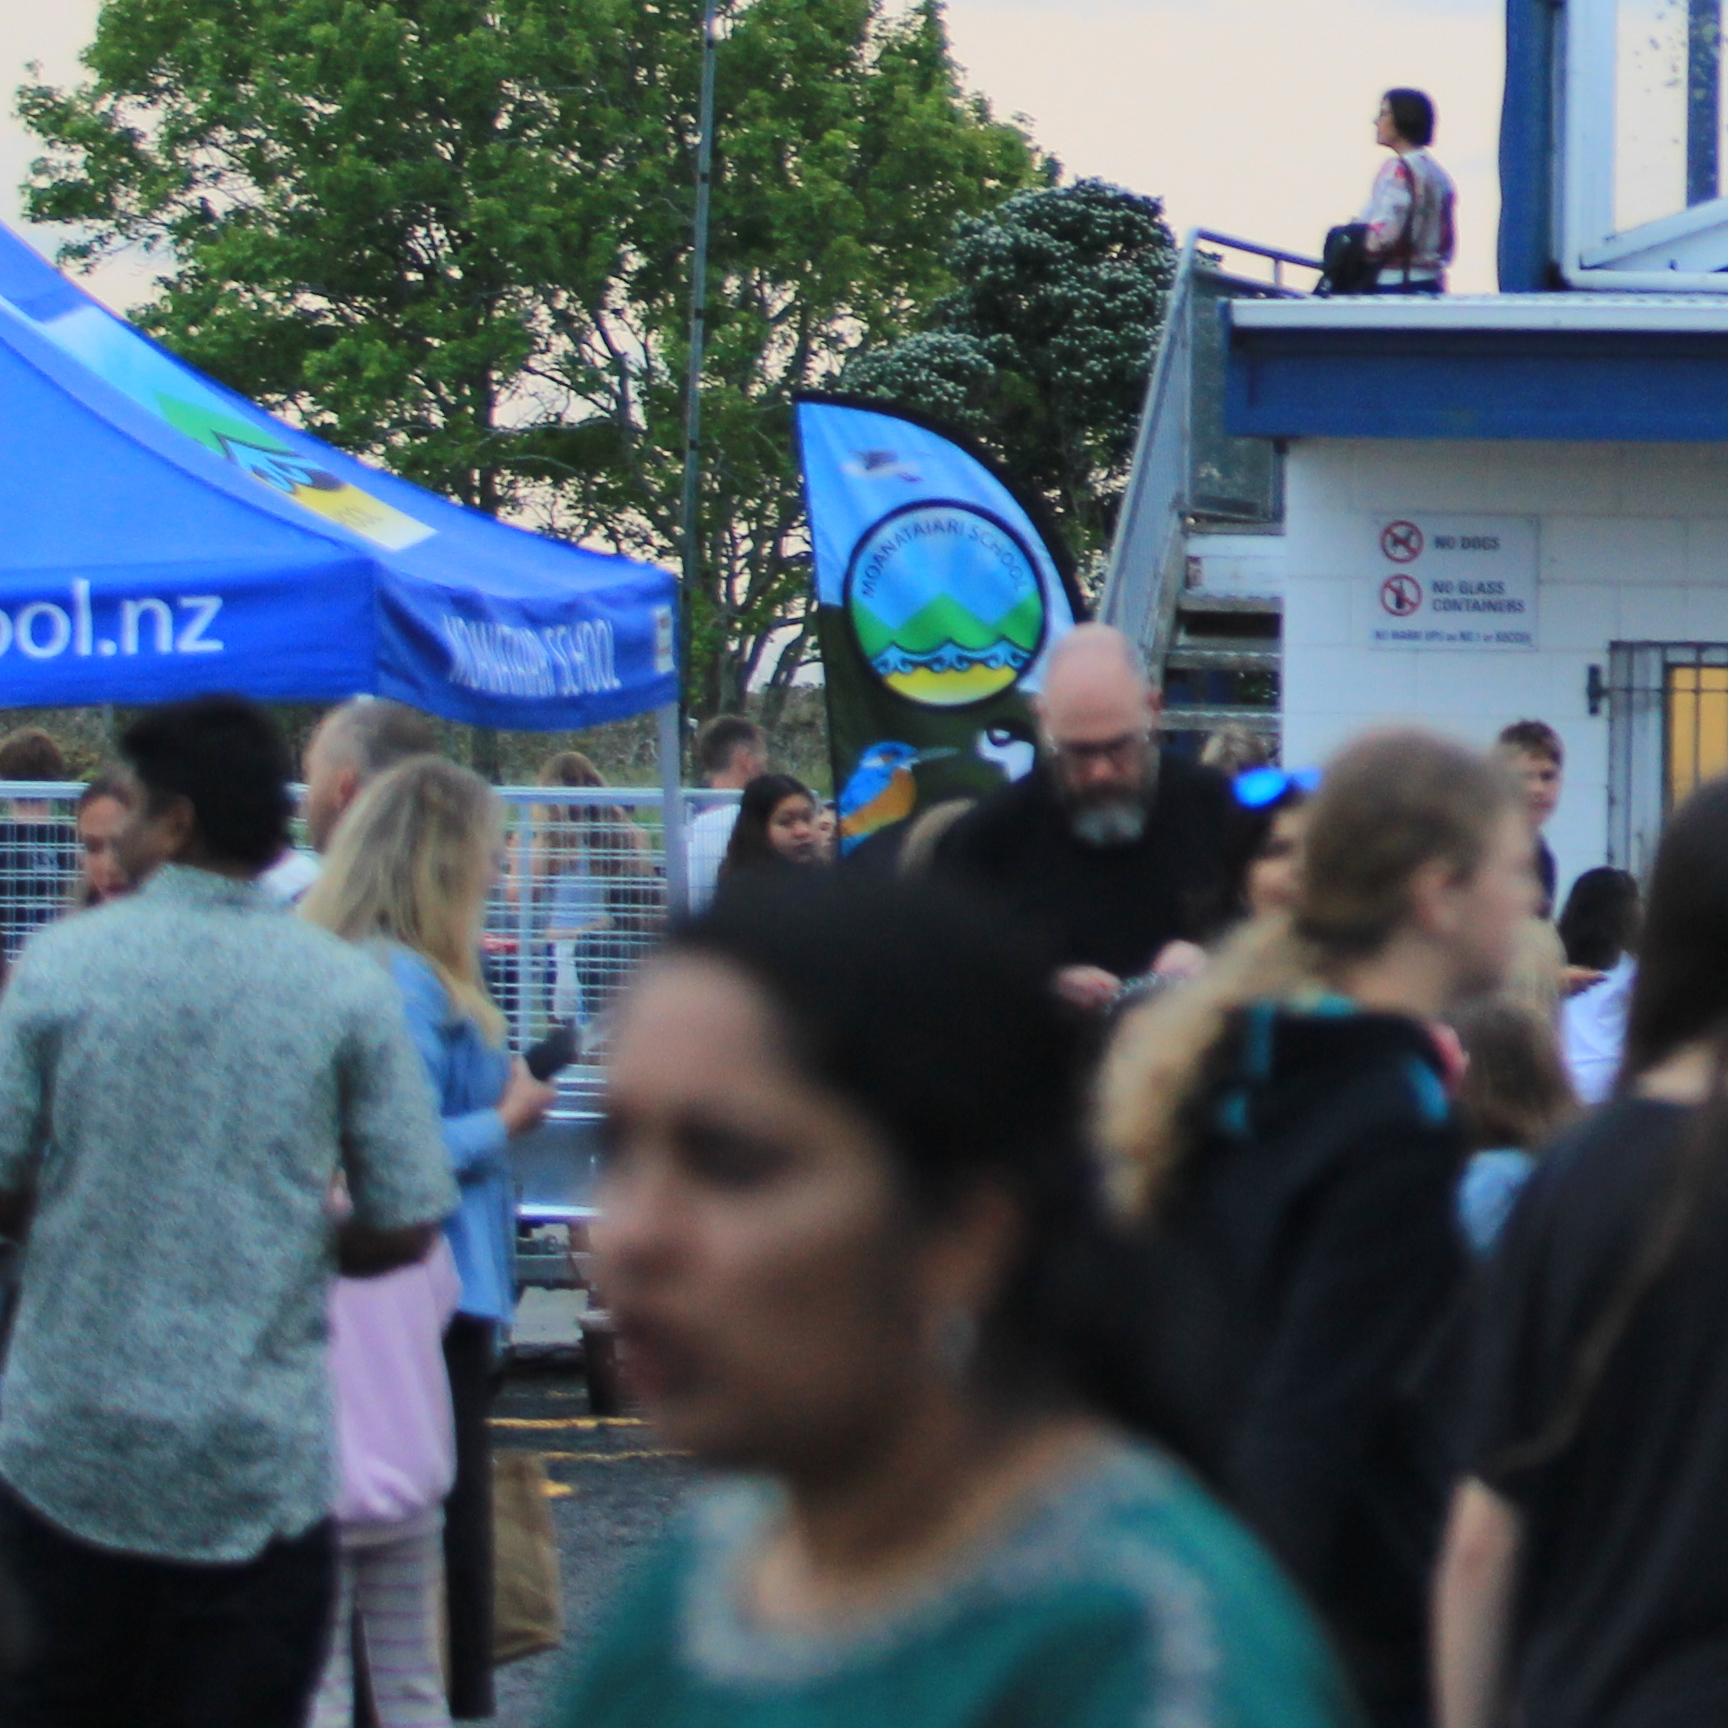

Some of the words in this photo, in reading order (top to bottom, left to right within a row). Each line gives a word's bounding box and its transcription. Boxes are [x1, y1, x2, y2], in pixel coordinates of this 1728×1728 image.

[1434, 535, 1456, 550] NO
[1460, 535, 1501, 551] DOGS
[862, 518, 964, 599] MOANATAIARI
[967, 524, 1026, 592] SCHOOL
[1432, 580, 1454, 595] NO
[1458, 580, 1506, 595] GLASS
[1431, 598, 1526, 614] CONTAINERS
[0, 578, 225, 659] ol.nz
